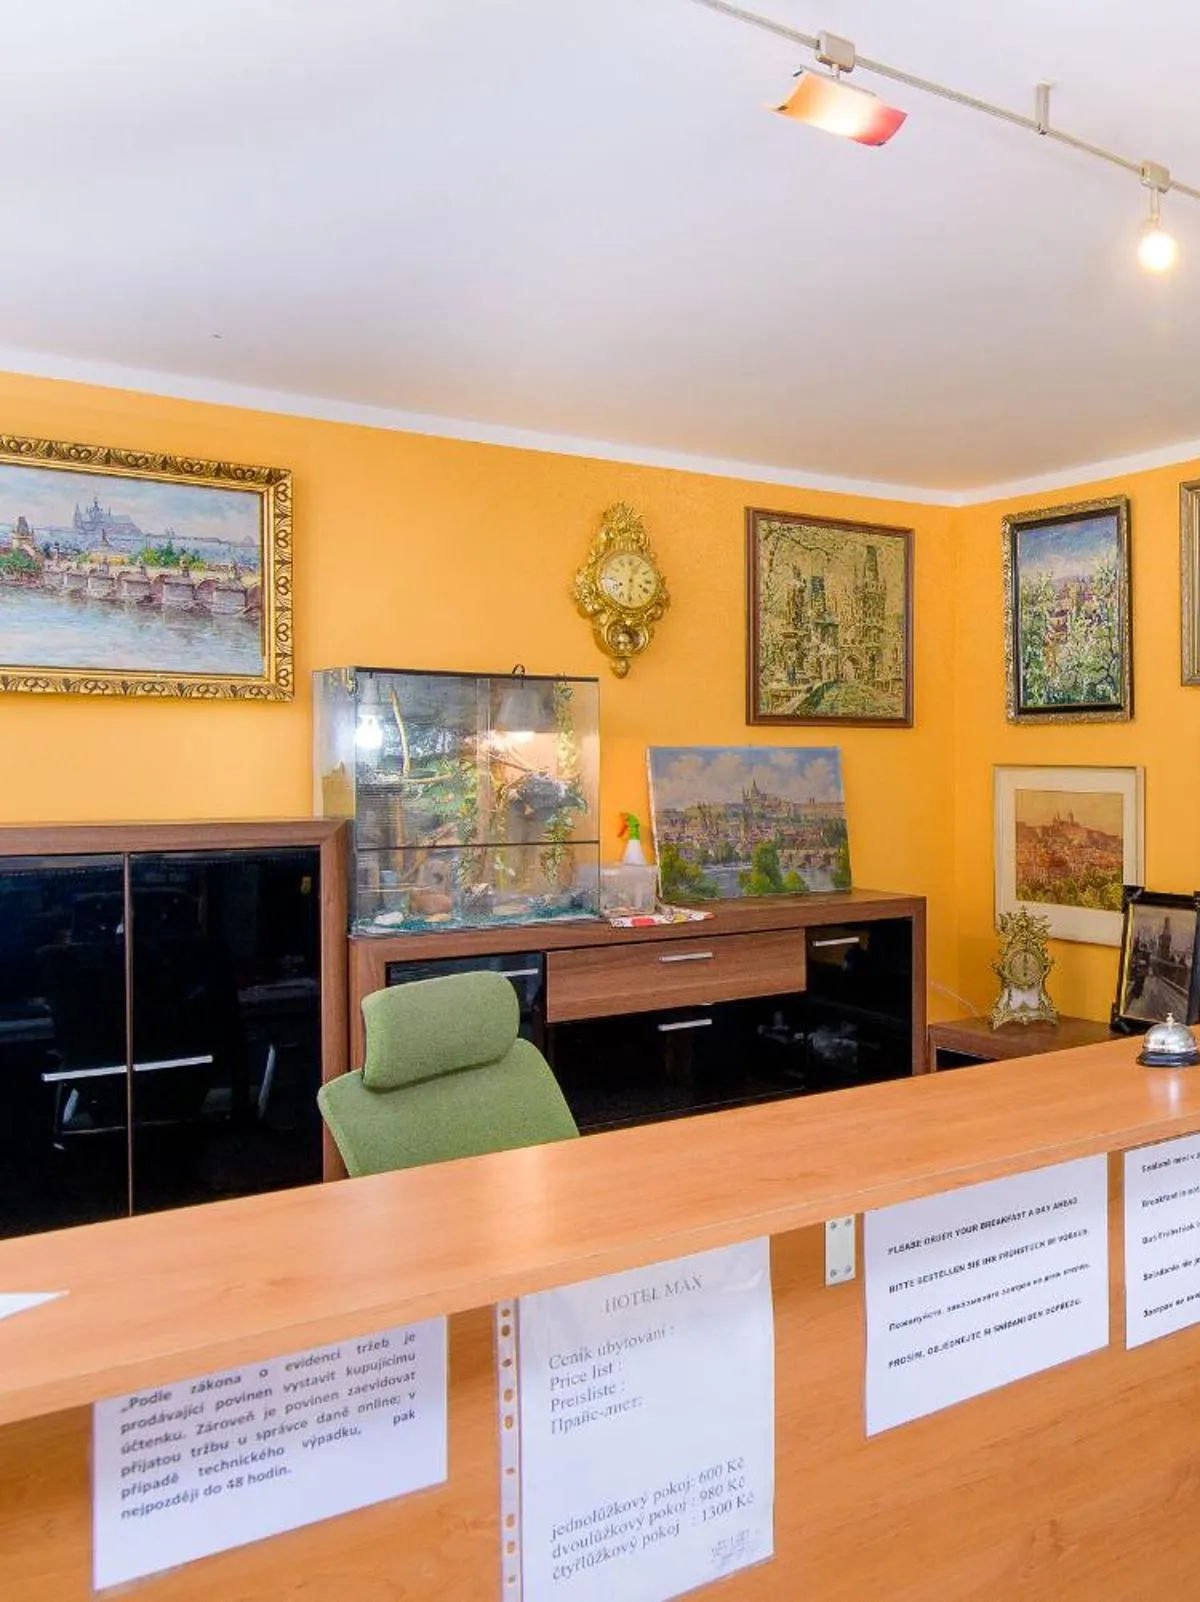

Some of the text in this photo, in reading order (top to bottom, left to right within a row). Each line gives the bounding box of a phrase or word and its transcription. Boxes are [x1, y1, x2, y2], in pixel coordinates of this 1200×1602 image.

[887, 1240, 922, 1256] PLEASE
[923, 1230, 953, 1246] ORDER
[954, 1223, 979, 1237] YOUR
[979, 1210, 1027, 1230] BREAKFAST
[605, 1274, 704, 1314] HOTEL MAX
[888, 1279, 915, 1294] BITTE
[917, 1263, 966, 1285] BESTELLEN
[967, 1259, 980, 1270] SIE
[190, 1374, 242, 1395] zákona
[258, 1368, 269, 1378] o
[284, 1347, 341, 1372] evidenci
[356, 1337, 390, 1355] tržeb
[403, 1331, 416, 1346] je
[548, 1346, 593, 1371] Ceník
[550, 1361, 613, 1392] Price list
[119, 1351, 416, 1435] prodávající povinen vystavit kupujícímu
[119, 1371, 416, 1456] účtenku. Zároveň je povinen zaevidovat
[550, 1384, 617, 1413] Preisliste
[120, 1452, 182, 1478] přijatou
[190, 1439, 230, 1459] tržbu
[237, 1436, 248, 1446] u
[255, 1419, 308, 1444] správce
[315, 1405, 350, 1425] daně
[408, 1390, 416, 1399] v
[120, 1472, 180, 1500] případě
[197, 1444, 285, 1478] technického
[392, 1408, 416, 1426] pak
[120, 1465, 292, 1520] nejpozději do 48 hodin.
[549, 1490, 650, 1543] jednolůžkový
[697, 1464, 723, 1484] 600
[726, 1456, 746, 1473] Kč
[551, 1475, 746, 1560] dvoulůžkový pokoj 980 Kč
[641, 1523, 681, 1550] pokoj
[701, 1500, 733, 1522] 1300
[735, 1490, 755, 1509] Kč
